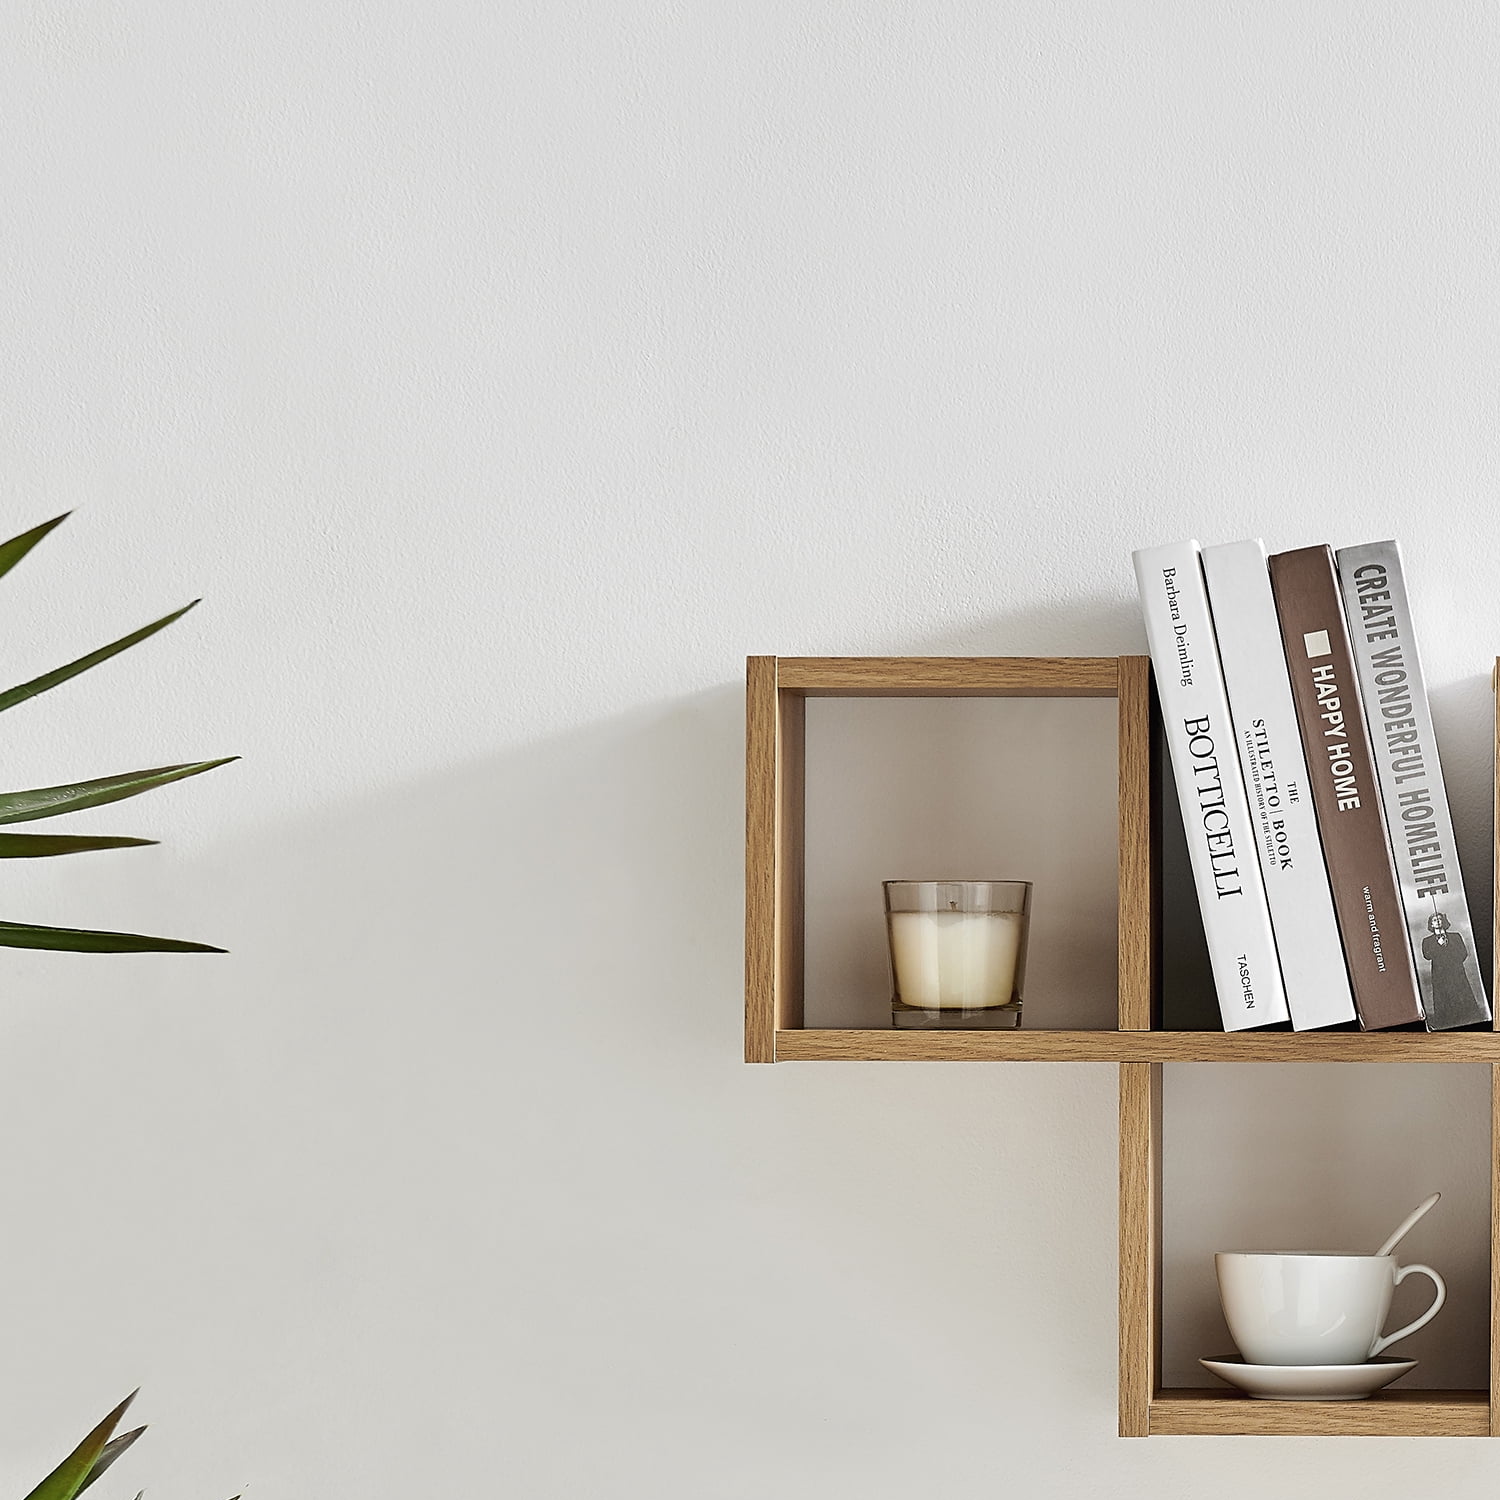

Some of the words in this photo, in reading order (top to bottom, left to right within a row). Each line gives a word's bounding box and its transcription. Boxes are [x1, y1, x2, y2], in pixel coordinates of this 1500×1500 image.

[1163, 568, 1180, 620] Barbara
[1174, 624, 1194, 687] Deimling
[1354, 564, 1398, 643] CREATE
[1311, 664, 1347, 737] HAPPY
[1371, 646, 1426, 784] WONDERFUL
[1246, 740, 1260, 782] ILLUSTRATED
[1327, 743, 1361, 812] HOME
[1184, 714, 1243, 900] BOTTICELLI
[1252, 719, 1280, 807] STILETTO
[1273, 820, 1293, 870] BOOK
[1255, 784, 1265, 810] HISTORY
[1287, 781, 1299, 804] THE
[1262, 822, 1270, 834] THE
[1265, 835, 1276, 865] STILETTO
[1398, 789, 1449, 899] HOMELIFE
[1363, 886, 1373, 912] warm
[1369, 914, 1379, 932] and
[1372, 933, 1386, 972] fragrant
[1236, 954, 1255, 1009] TASCHEN
